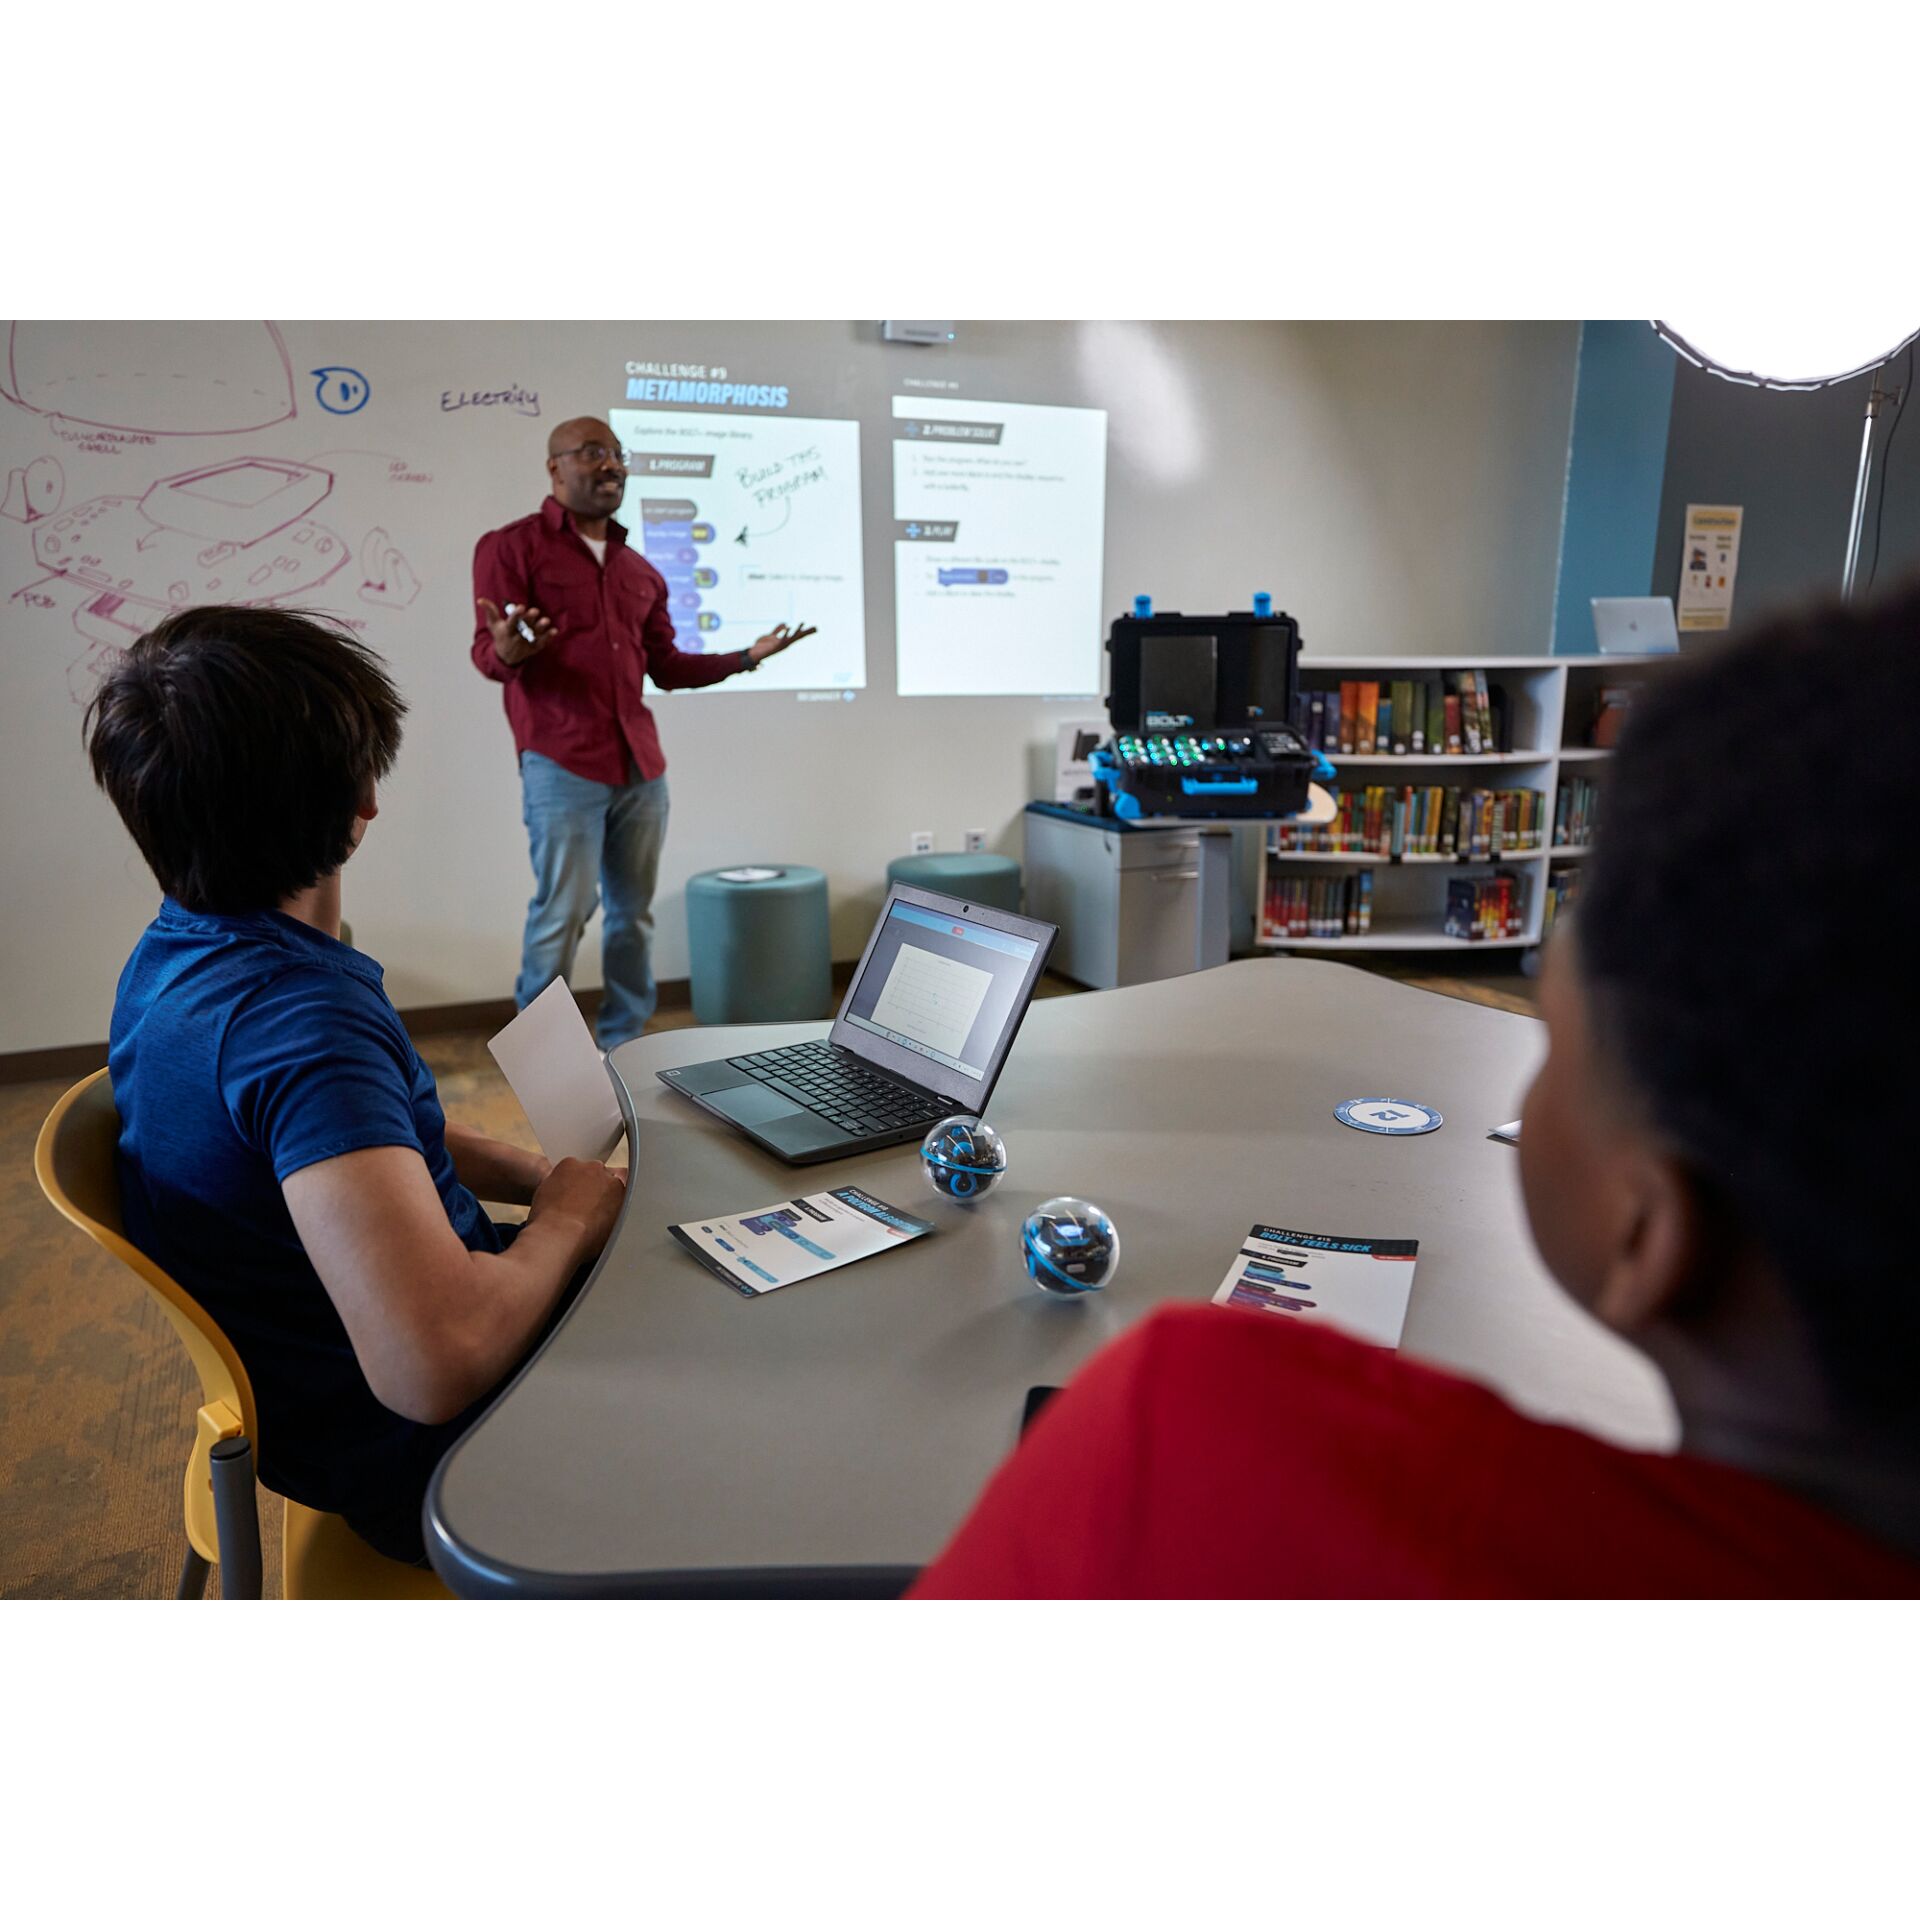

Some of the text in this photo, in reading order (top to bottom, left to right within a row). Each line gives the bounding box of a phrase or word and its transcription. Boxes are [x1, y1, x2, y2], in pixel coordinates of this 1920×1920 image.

[625, 361, 727, 380] CHALLENGE #9
[625, 377, 789, 408] METAMORPHOSIS
[1369, 1109, 1411, 1121] 12
[1259, 1231, 1297, 1244] BOLT+
[1300, 1239, 1340, 1251] FEELS
[1339, 1243, 1373, 1253] SICK
[1263, 1227, 1313, 1240] CHALLENGE
